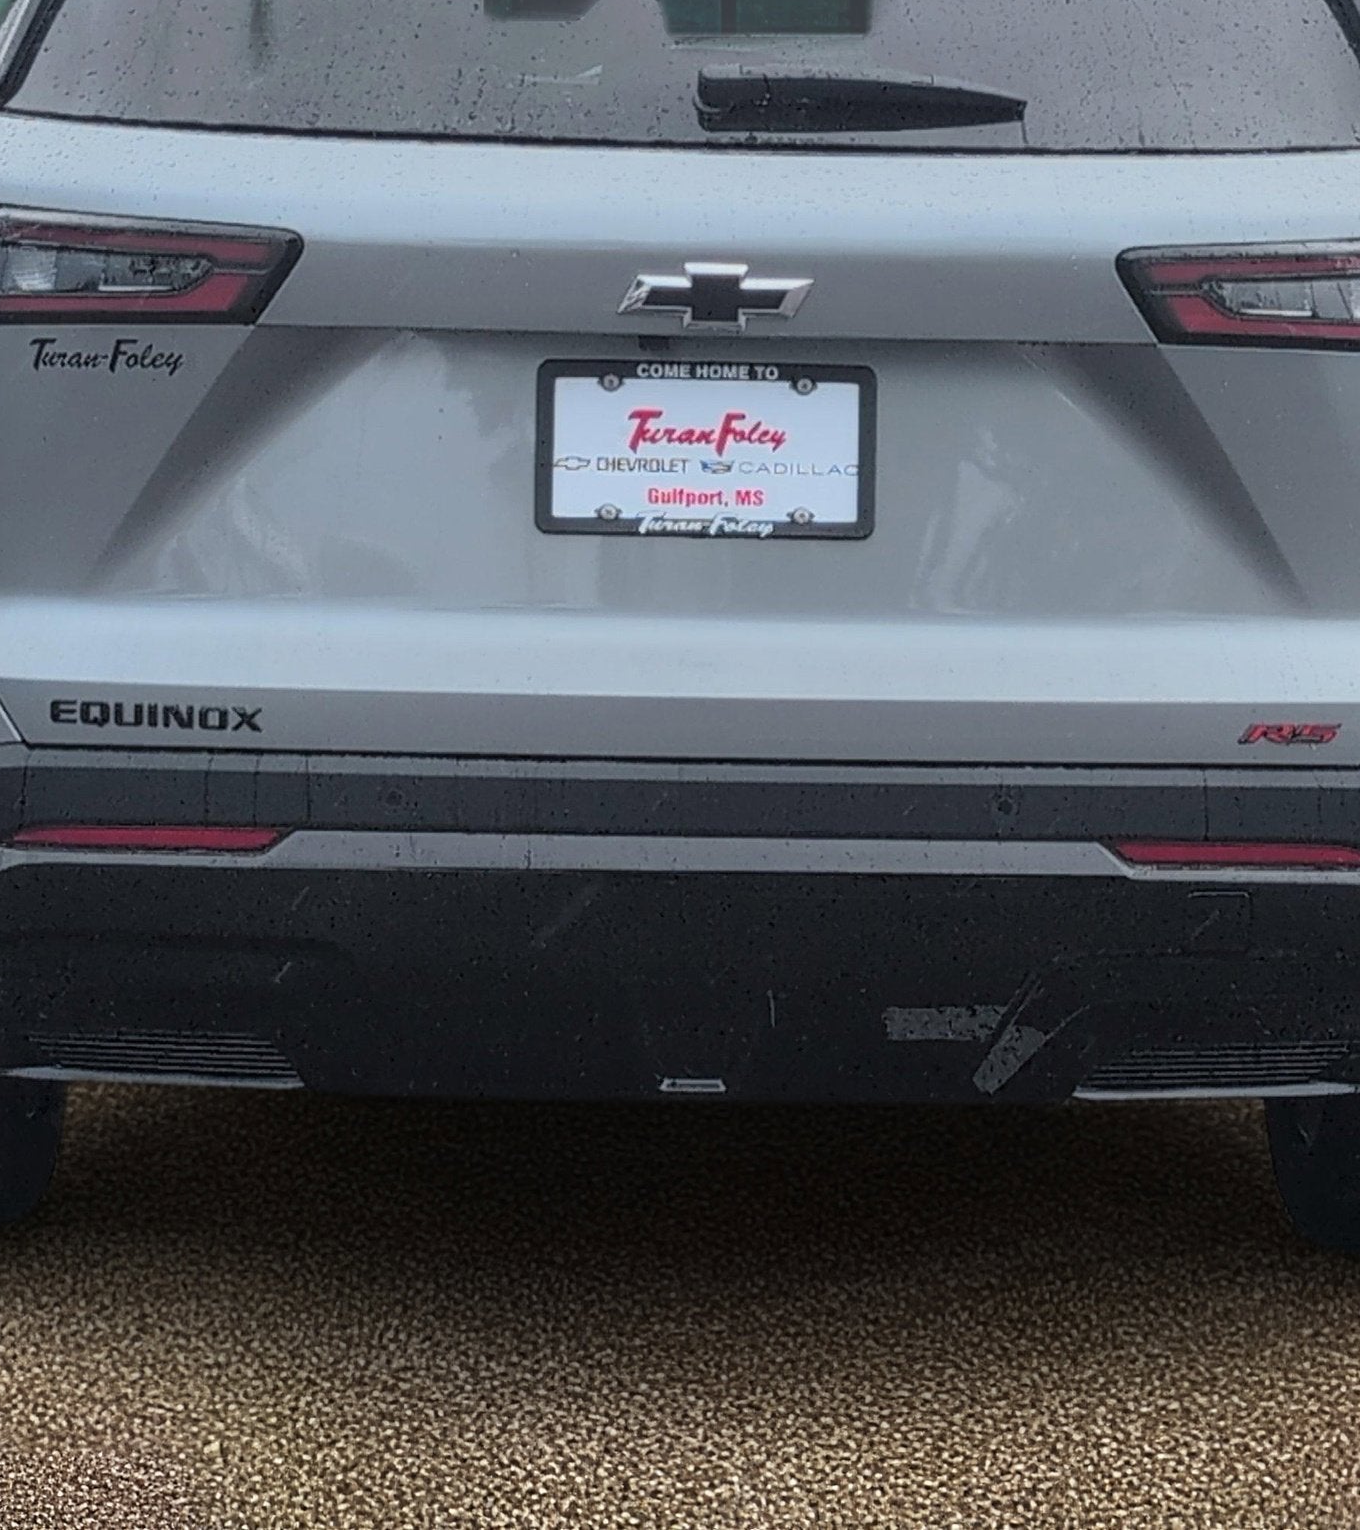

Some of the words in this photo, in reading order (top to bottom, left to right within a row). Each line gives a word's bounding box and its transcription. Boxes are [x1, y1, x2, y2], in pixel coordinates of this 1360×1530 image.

[637, 364, 690, 378] COME
[695, 365, 750, 380] HOME
[754, 367, 780, 380] TO
[596, 458, 690, 473] CHEVROLET
[738, 461, 859, 477] CADILLAC
[648, 488, 729, 507] Gulfport,
[735, 490, 765, 506] MS
[50, 700, 262, 733] EQUINOX
[1238, 723, 1342, 745] RS
